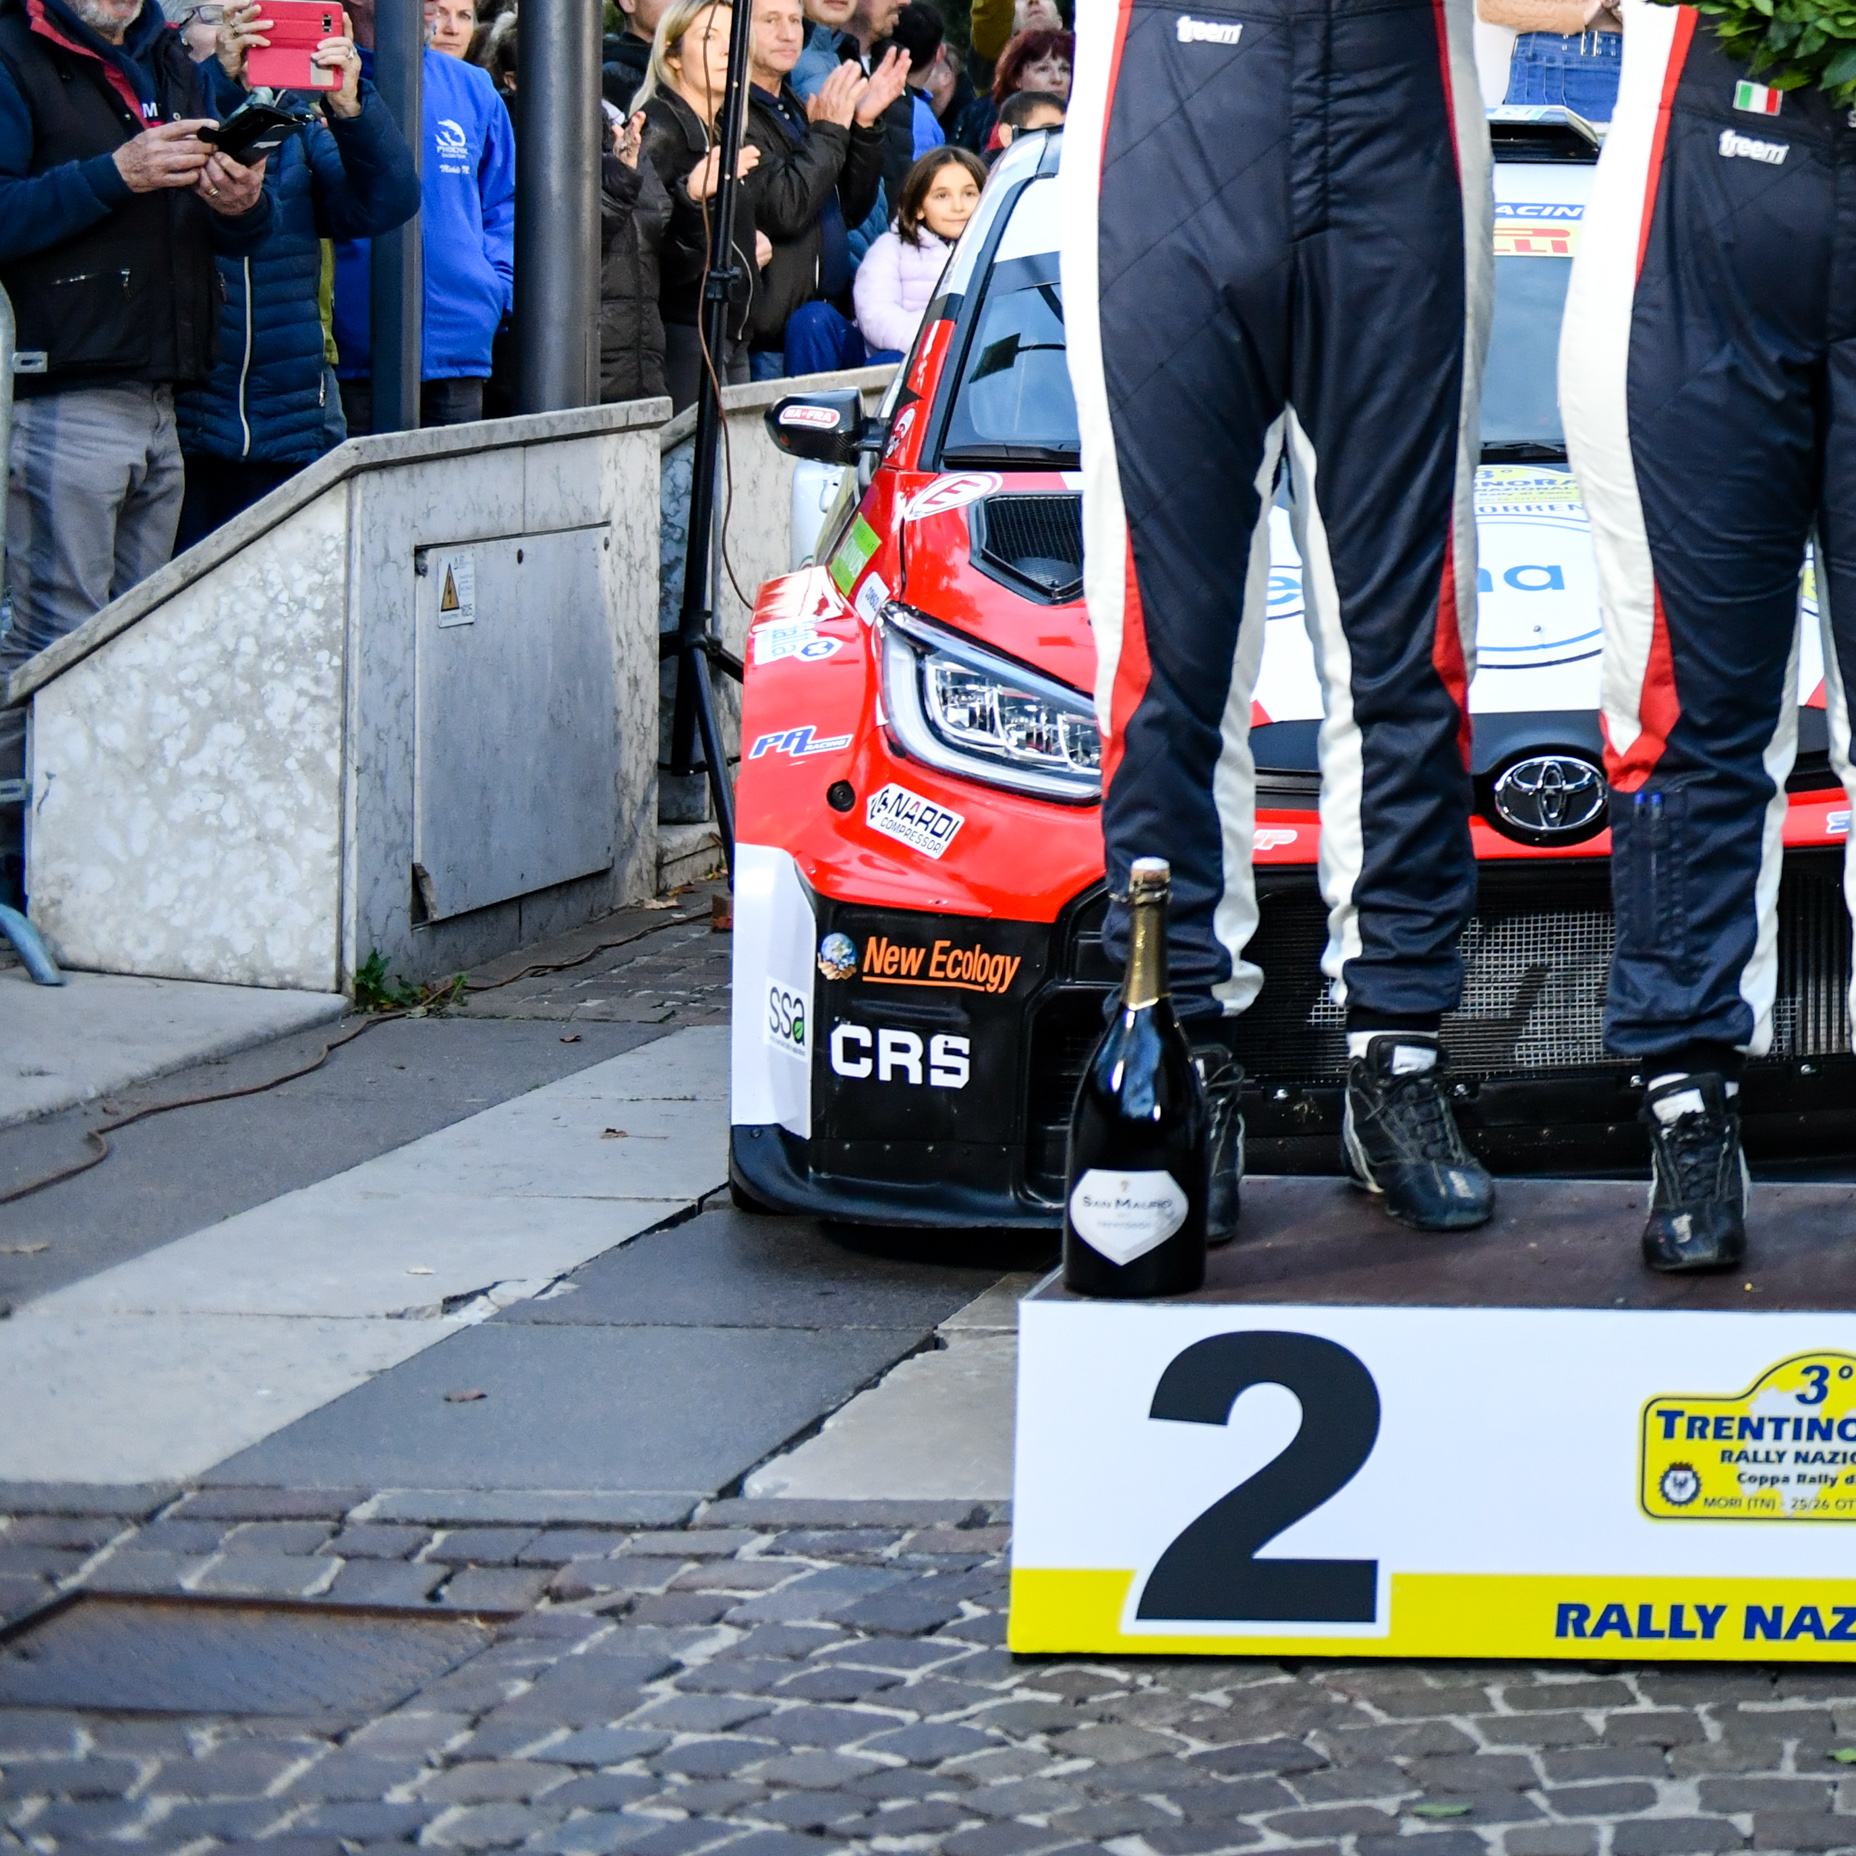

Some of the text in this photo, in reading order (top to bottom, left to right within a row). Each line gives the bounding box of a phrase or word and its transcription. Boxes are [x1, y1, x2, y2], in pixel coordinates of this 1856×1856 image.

[1176, 15, 1243, 44] freem
[1719, 129, 1790, 165] freem
[1495, 205, 1583, 217] ACIN
[804, 737, 849, 752] RACING
[880, 816, 945, 855] COMPRESSORI
[889, 792, 961, 842] NARDI
[862, 936, 1021, 993] New Ecology
[769, 986, 805, 1047] ssa
[830, 1024, 971, 1089] CRS
[1796, 1364, 1854, 1405] 3°
[1720, 1449, 1787, 1465] RALLY
[1136, 1331, 1381, 1623] 2
[1737, 1472, 1790, 1488] Coppa
[1797, 1472, 1838, 1487] Rally
[1702, 1496, 1742, 1509] MORI
[1747, 1496, 1776, 1512] (TN)
[1790, 1497, 1830, 1511] 25/26
[1555, 1602, 1729, 1642] RALLY
